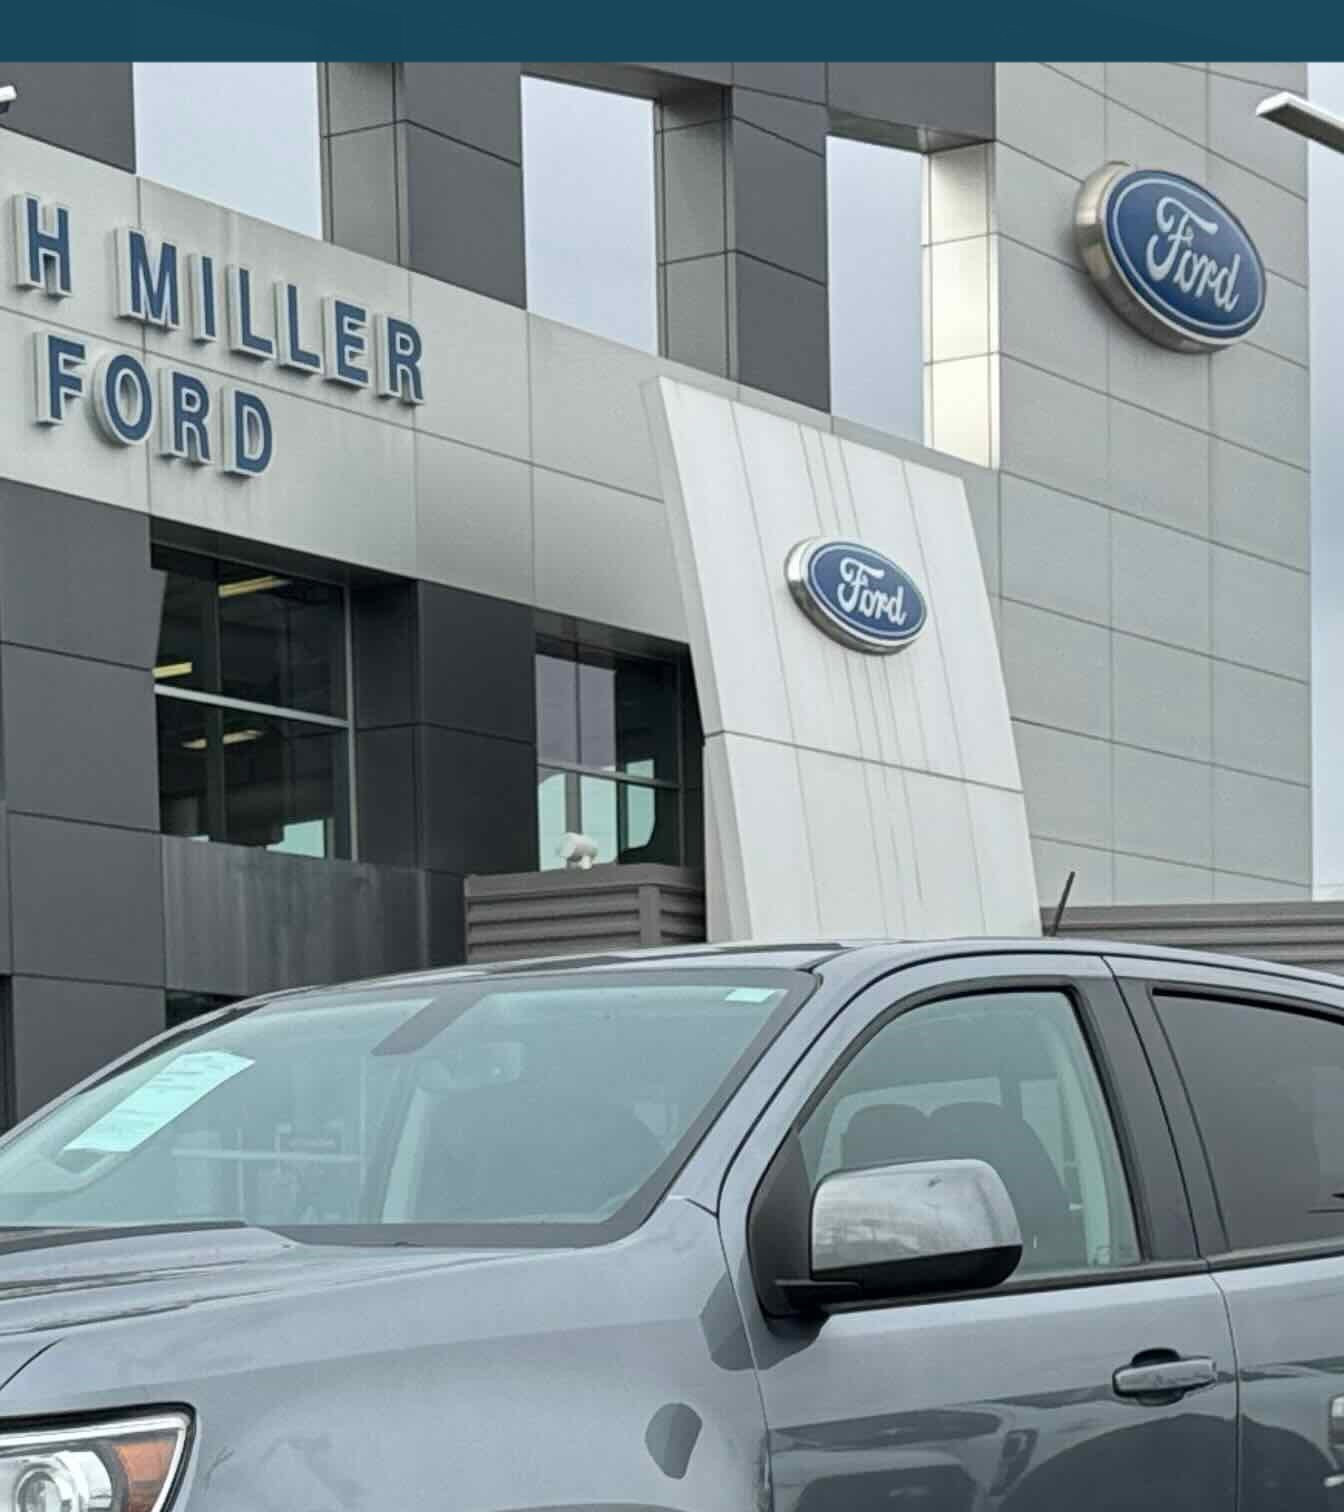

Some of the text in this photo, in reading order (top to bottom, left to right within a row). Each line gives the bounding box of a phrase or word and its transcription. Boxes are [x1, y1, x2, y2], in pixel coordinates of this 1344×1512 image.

[15, 193, 73, 297] H
[115, 226, 425, 404] MILLER
[1145, 196, 1242, 313] Ford
[35, 330, 275, 476] FORD
[836, 555, 908, 629] Ford
